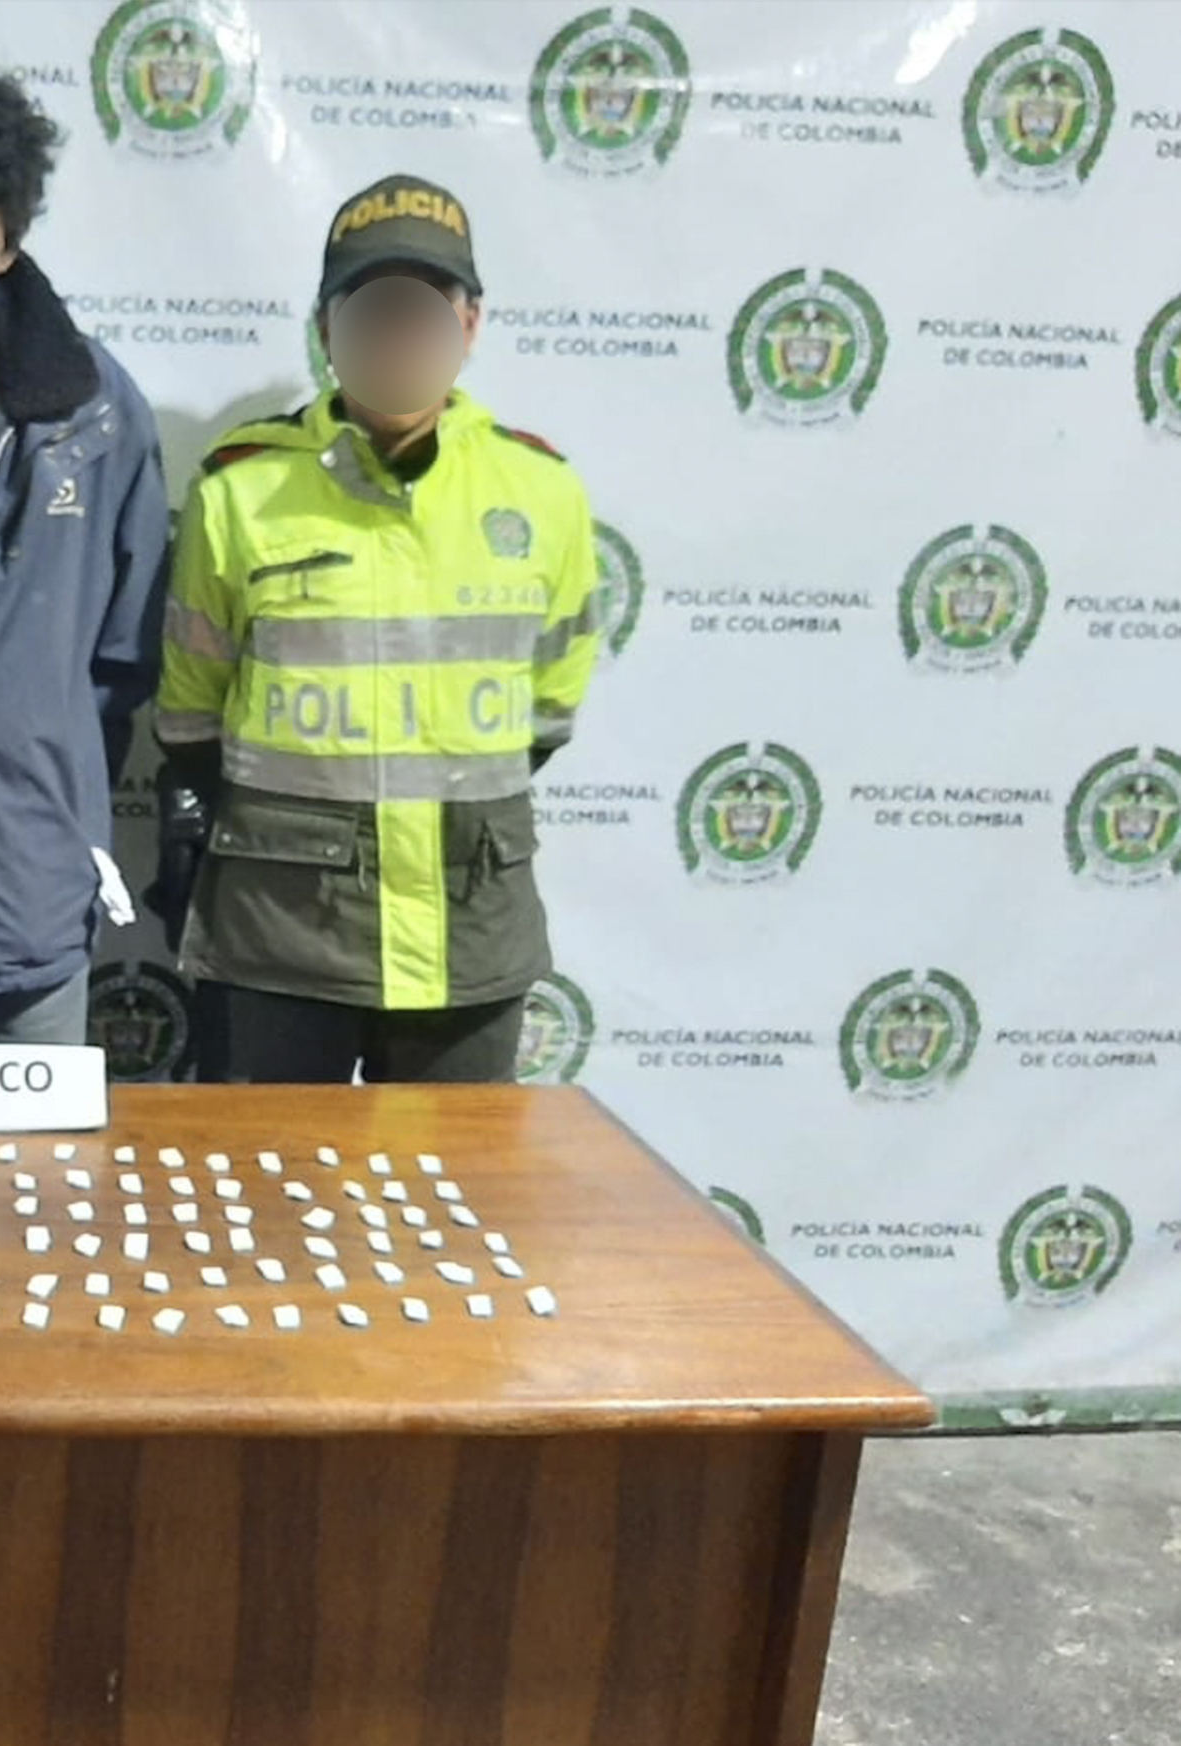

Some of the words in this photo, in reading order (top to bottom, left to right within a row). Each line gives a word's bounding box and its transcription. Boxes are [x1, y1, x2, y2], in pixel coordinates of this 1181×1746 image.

[384, 79, 514, 104] NACIONAL
[310, 105, 342, 125] DE
[813, 96, 937, 118] NACIONAL
[778, 124, 902, 145] COLOMBIA
[331, 189, 466, 241] POLICIA
[166, 299, 295, 319] NACIONAL
[588, 310, 711, 331] NACIONAL
[95, 324, 123, 343] DE
[131, 325, 259, 345] COLOMBIA
[1007, 324, 1121, 345] NACIONAL
[517, 337, 545, 355] DE
[553, 337, 678, 357] COLOMBIA
[943, 347, 969, 365] DE
[976, 350, 1088, 370] COLOMBIA
[759, 590, 875, 609] NACIONAL
[691, 615, 719, 633] DE
[726, 617, 841, 634] COLOMBIA
[1089, 621, 1113, 639] DE
[546, 785, 661, 802] NACIONAL
[943, 787, 1053, 804] NACIONAL
[530, 808, 630, 824] OLOMBIA
[874, 810, 903, 827] DE
[911, 810, 1023, 828] COLOMBIA
[705, 1029, 815, 1047] NACIONAL
[1083, 1030, 1181, 1044] NACIONA
[637, 1052, 665, 1067] DE
[670, 1052, 785, 1067] COLOMBIA
[1019, 1052, 1045, 1067] DE
[1052, 1052, 1156, 1067] COLOMBIA
[878, 1222, 983, 1238] NACIONAL
[814, 1245, 838, 1259] DE
[844, 1245, 954, 1259] COLOMBIA
